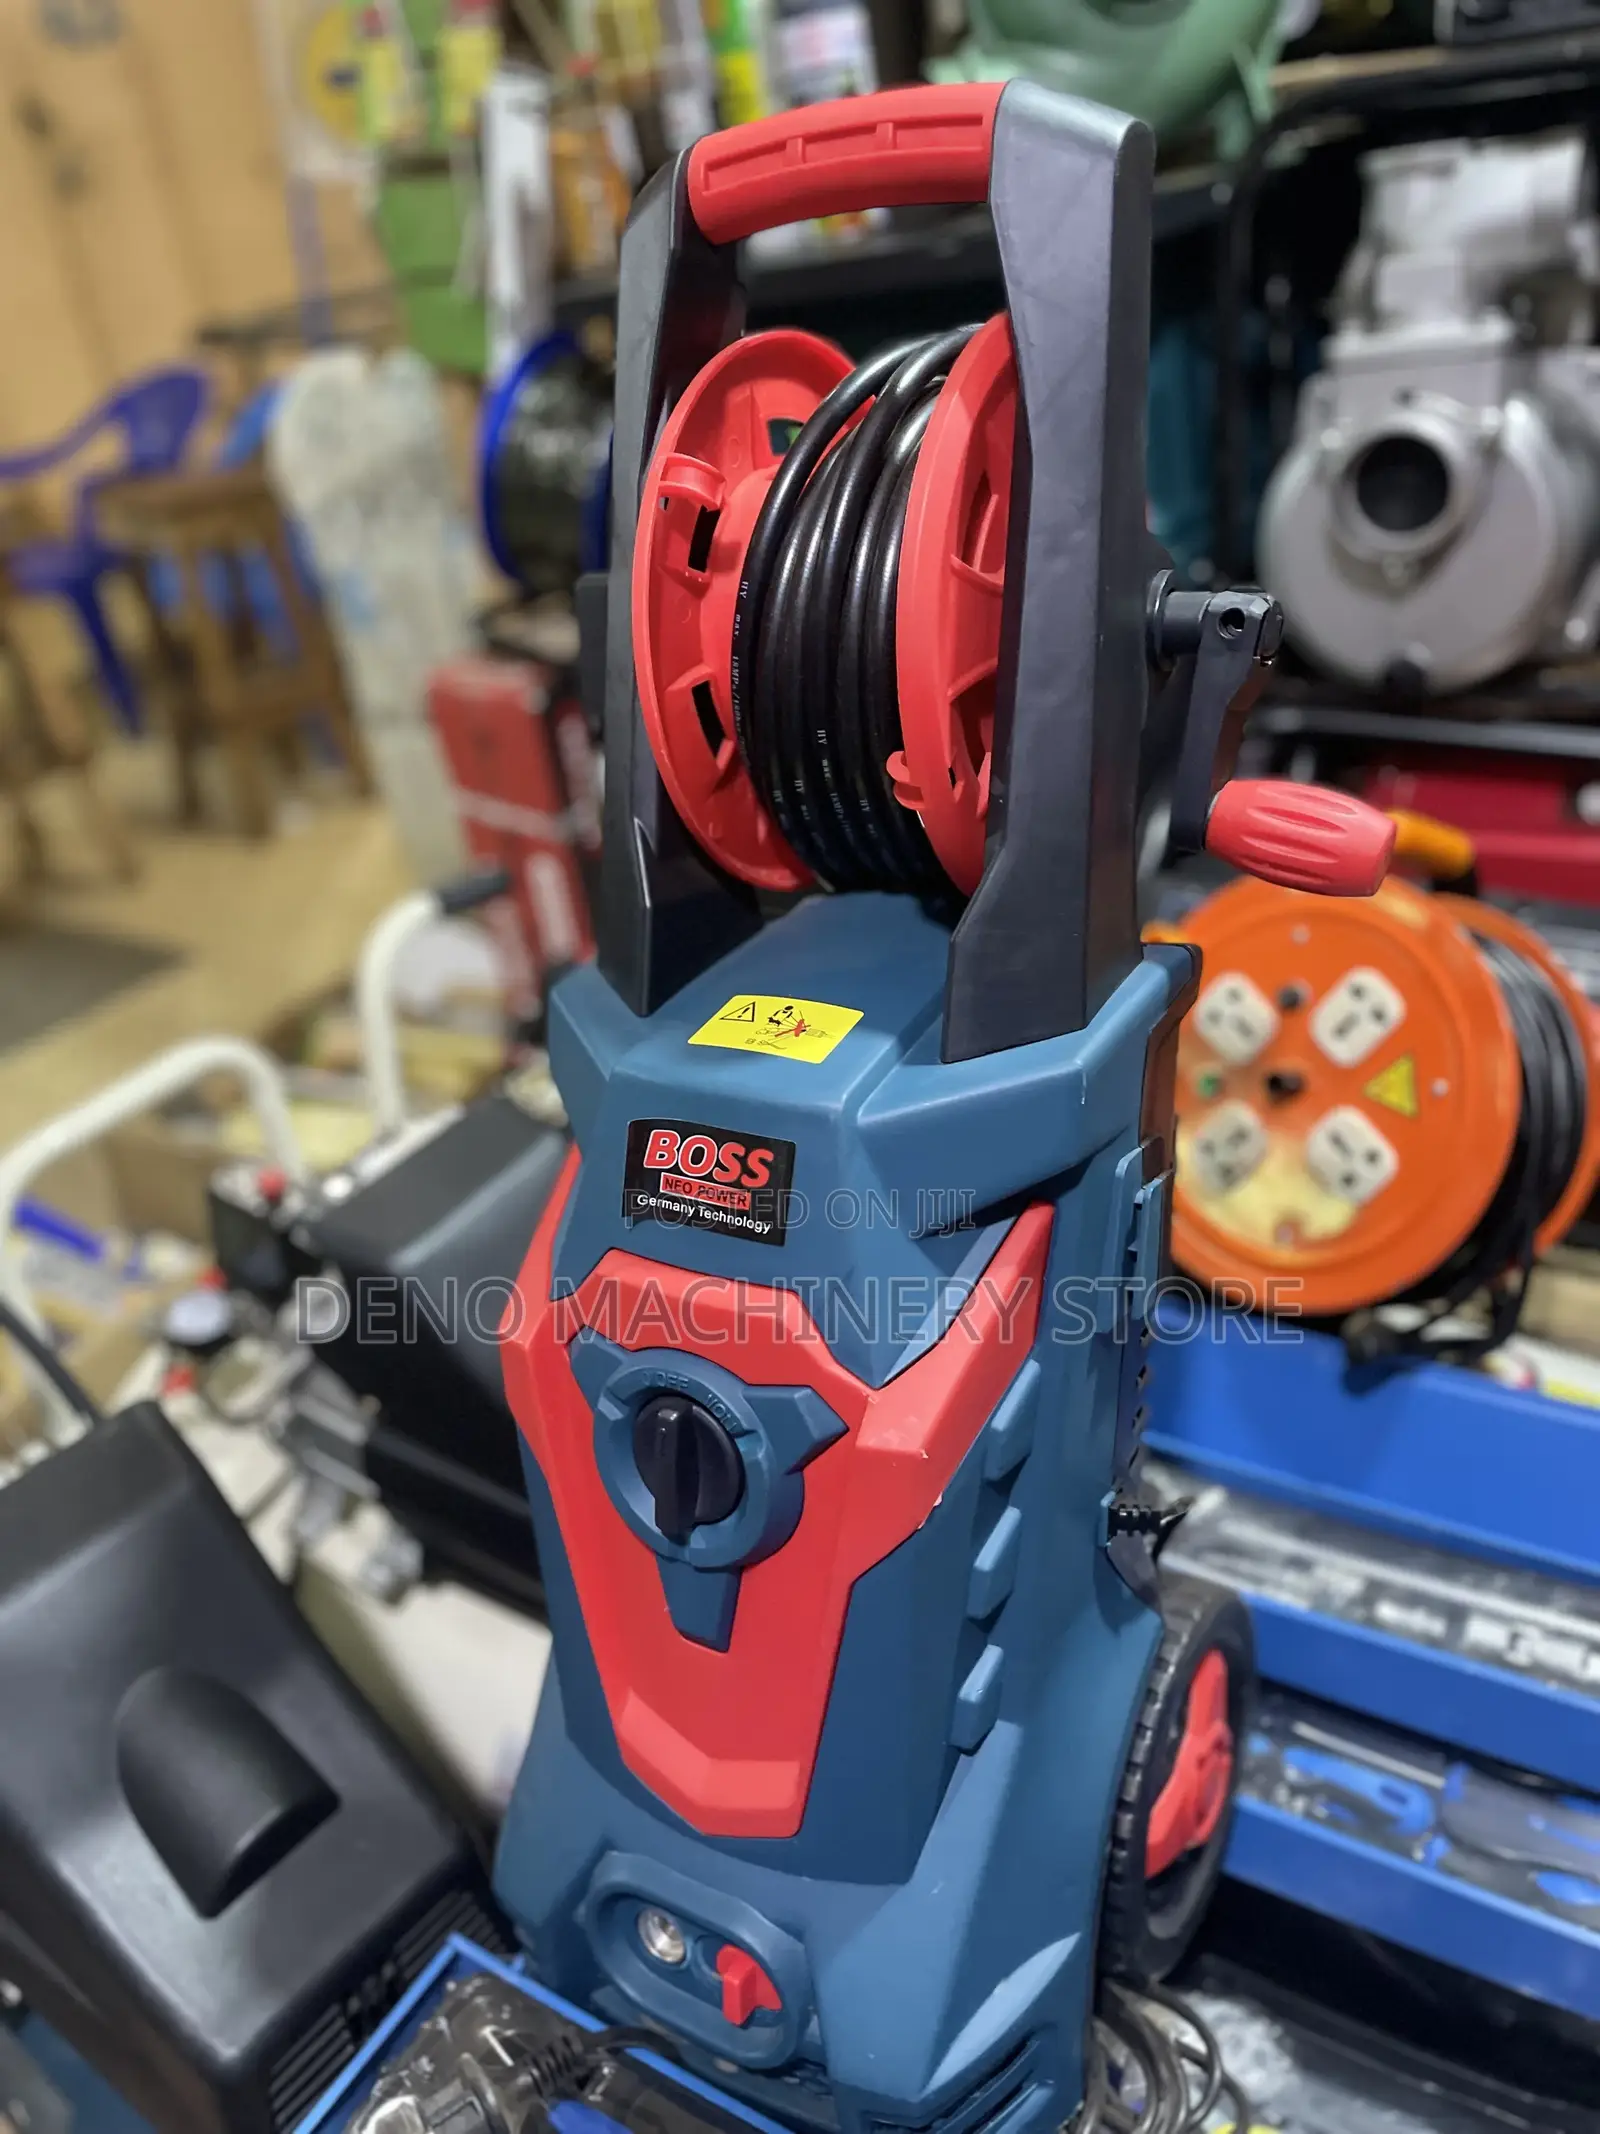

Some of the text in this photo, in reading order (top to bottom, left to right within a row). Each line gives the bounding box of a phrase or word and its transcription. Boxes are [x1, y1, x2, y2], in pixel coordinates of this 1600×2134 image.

[643, 1129, 774, 1188] BOSS
[637, 1194, 771, 1235] Germany Technology
[697, 1185, 747, 1207] POWER
